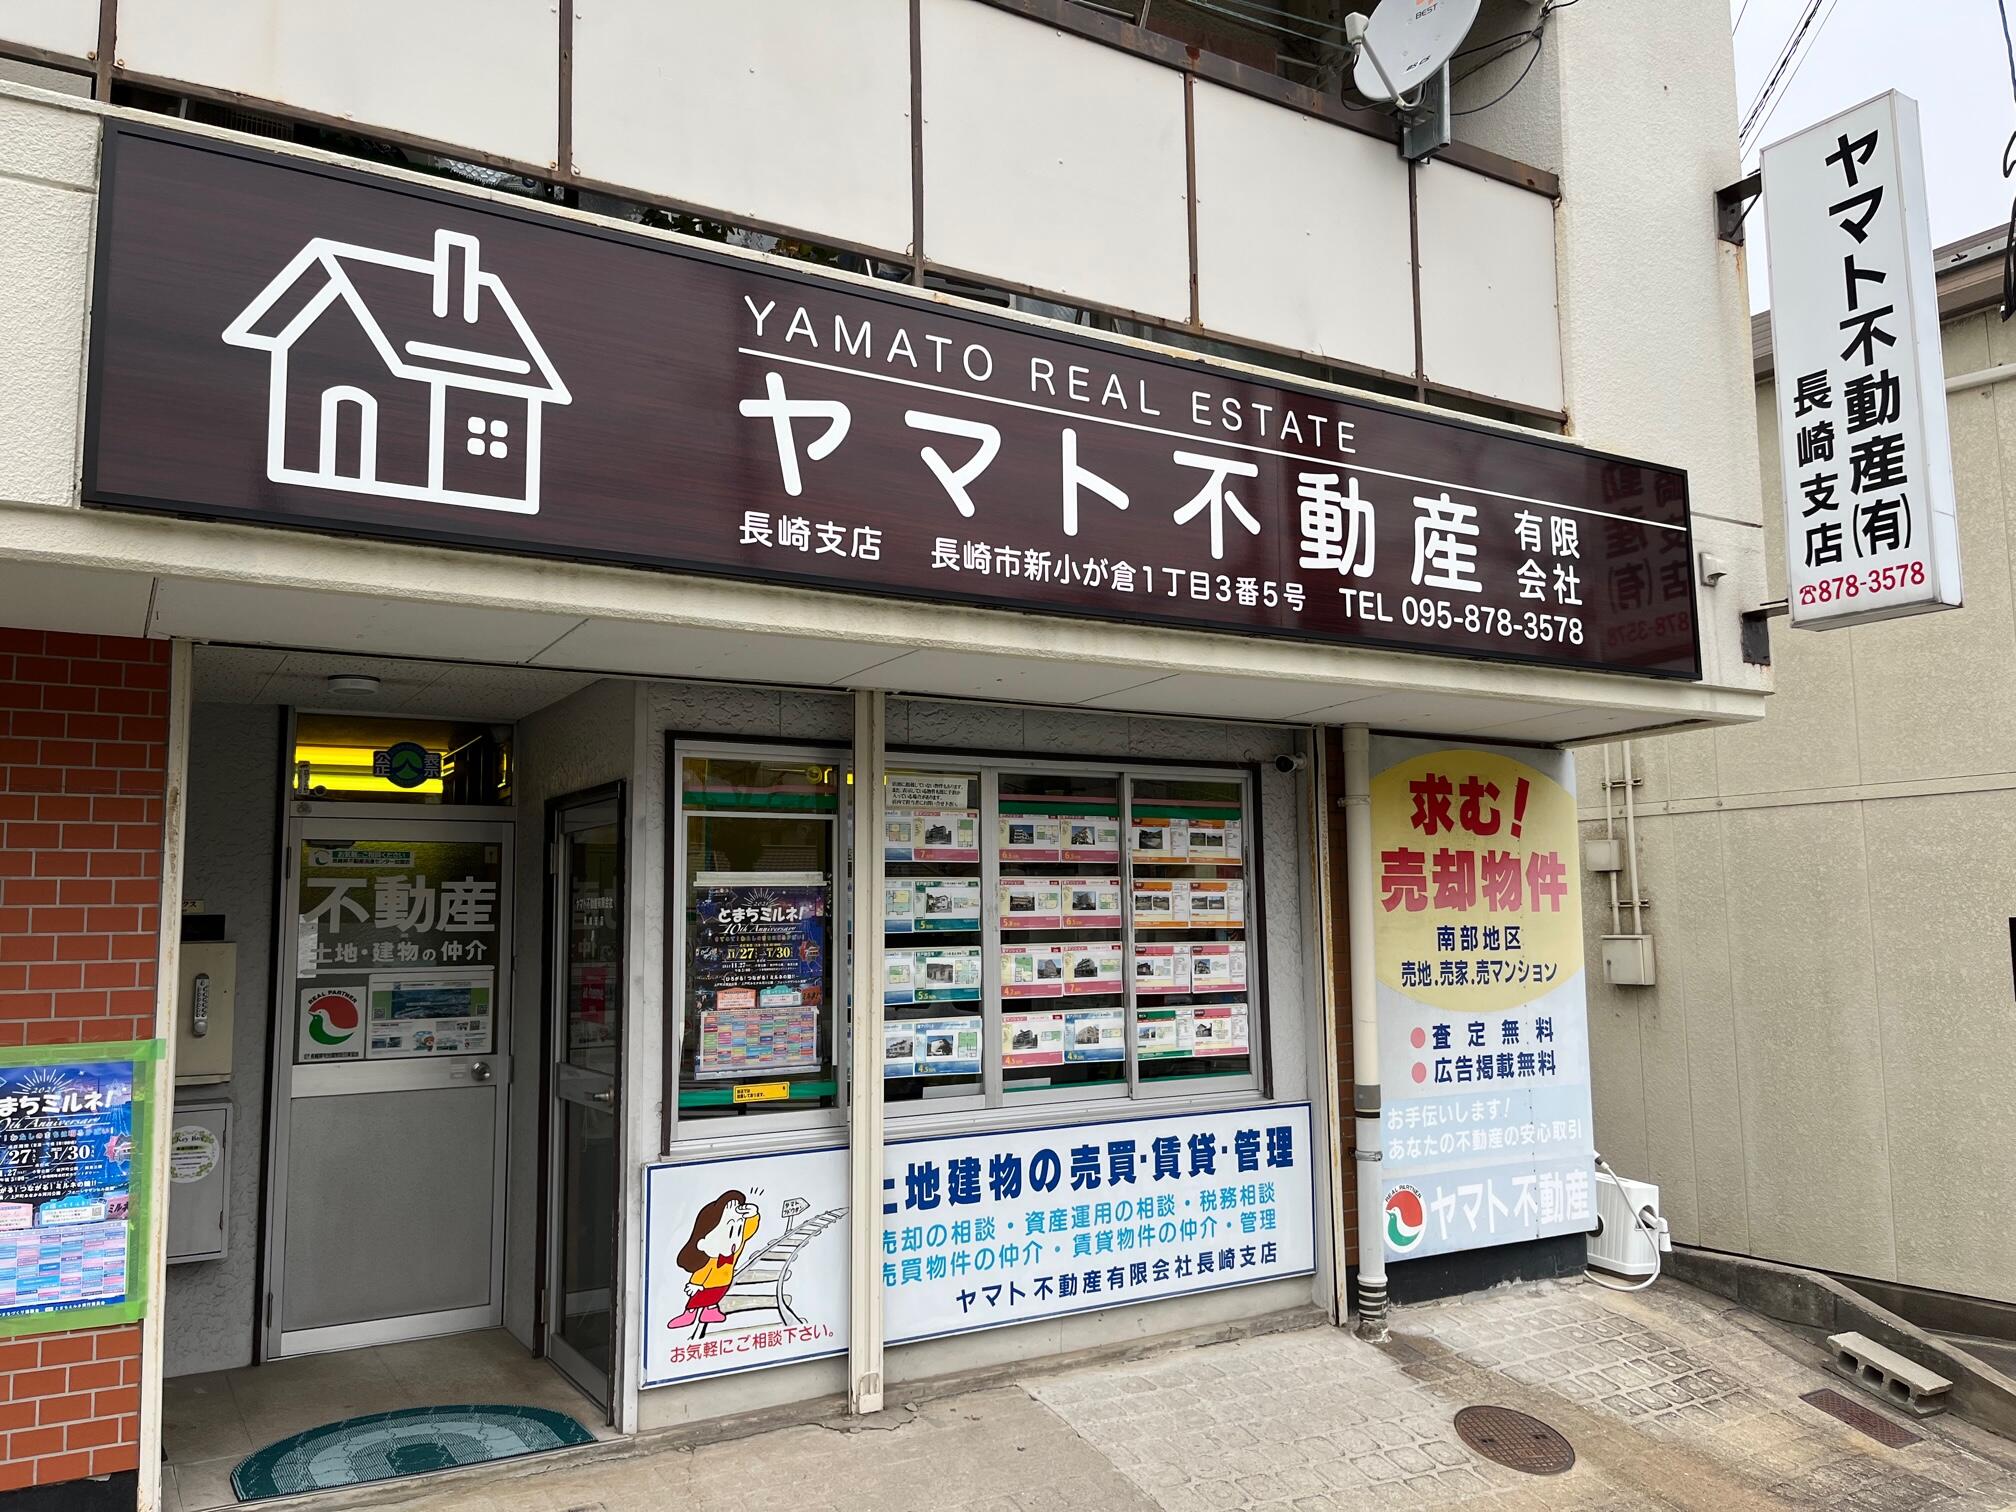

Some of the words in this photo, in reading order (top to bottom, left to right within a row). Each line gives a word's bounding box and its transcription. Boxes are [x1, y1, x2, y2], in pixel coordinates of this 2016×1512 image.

[744, 294, 994, 382] YAMATO
[1031, 357, 1161, 417] REAL
[1192, 390, 1357, 454] ESTATE
[738, 371, 1483, 594] ヤマト不動産
[1793, 368, 1843, 569] 長崎支店
[738, 510, 882, 561] 長崎支店
[931, 536, 1306, 613] 長崎市新小が倉1丁目3番5号
[1818, 560, 1926, 604] 878-3578
[1339, 587, 1394, 623] TEL
[1402, 595, 1584, 645] 095-878-3578
[1409, 773, 1530, 839] 求む！
[302, 875, 497, 934] 不動産
[1381, 847, 1568, 912] 売却物件
[1436, 925, 1522, 952] 南部地区
[1432, 1016, 1554, 1050] 査定無料
[1434, 1050, 1557, 1084] 広告掲載無料
[1387, 1097, 1512, 1131] お手伝いします！
[1388, 1119, 1583, 1161] あなたの不動産の安心取引
[1430, 1169, 1590, 1241] ヤマト不動産
[955, 1241, 1278, 1314] ヤマト不動産有限会社長崎支店
[669, 1323, 834, 1364] お気軽にご相談下さい。
